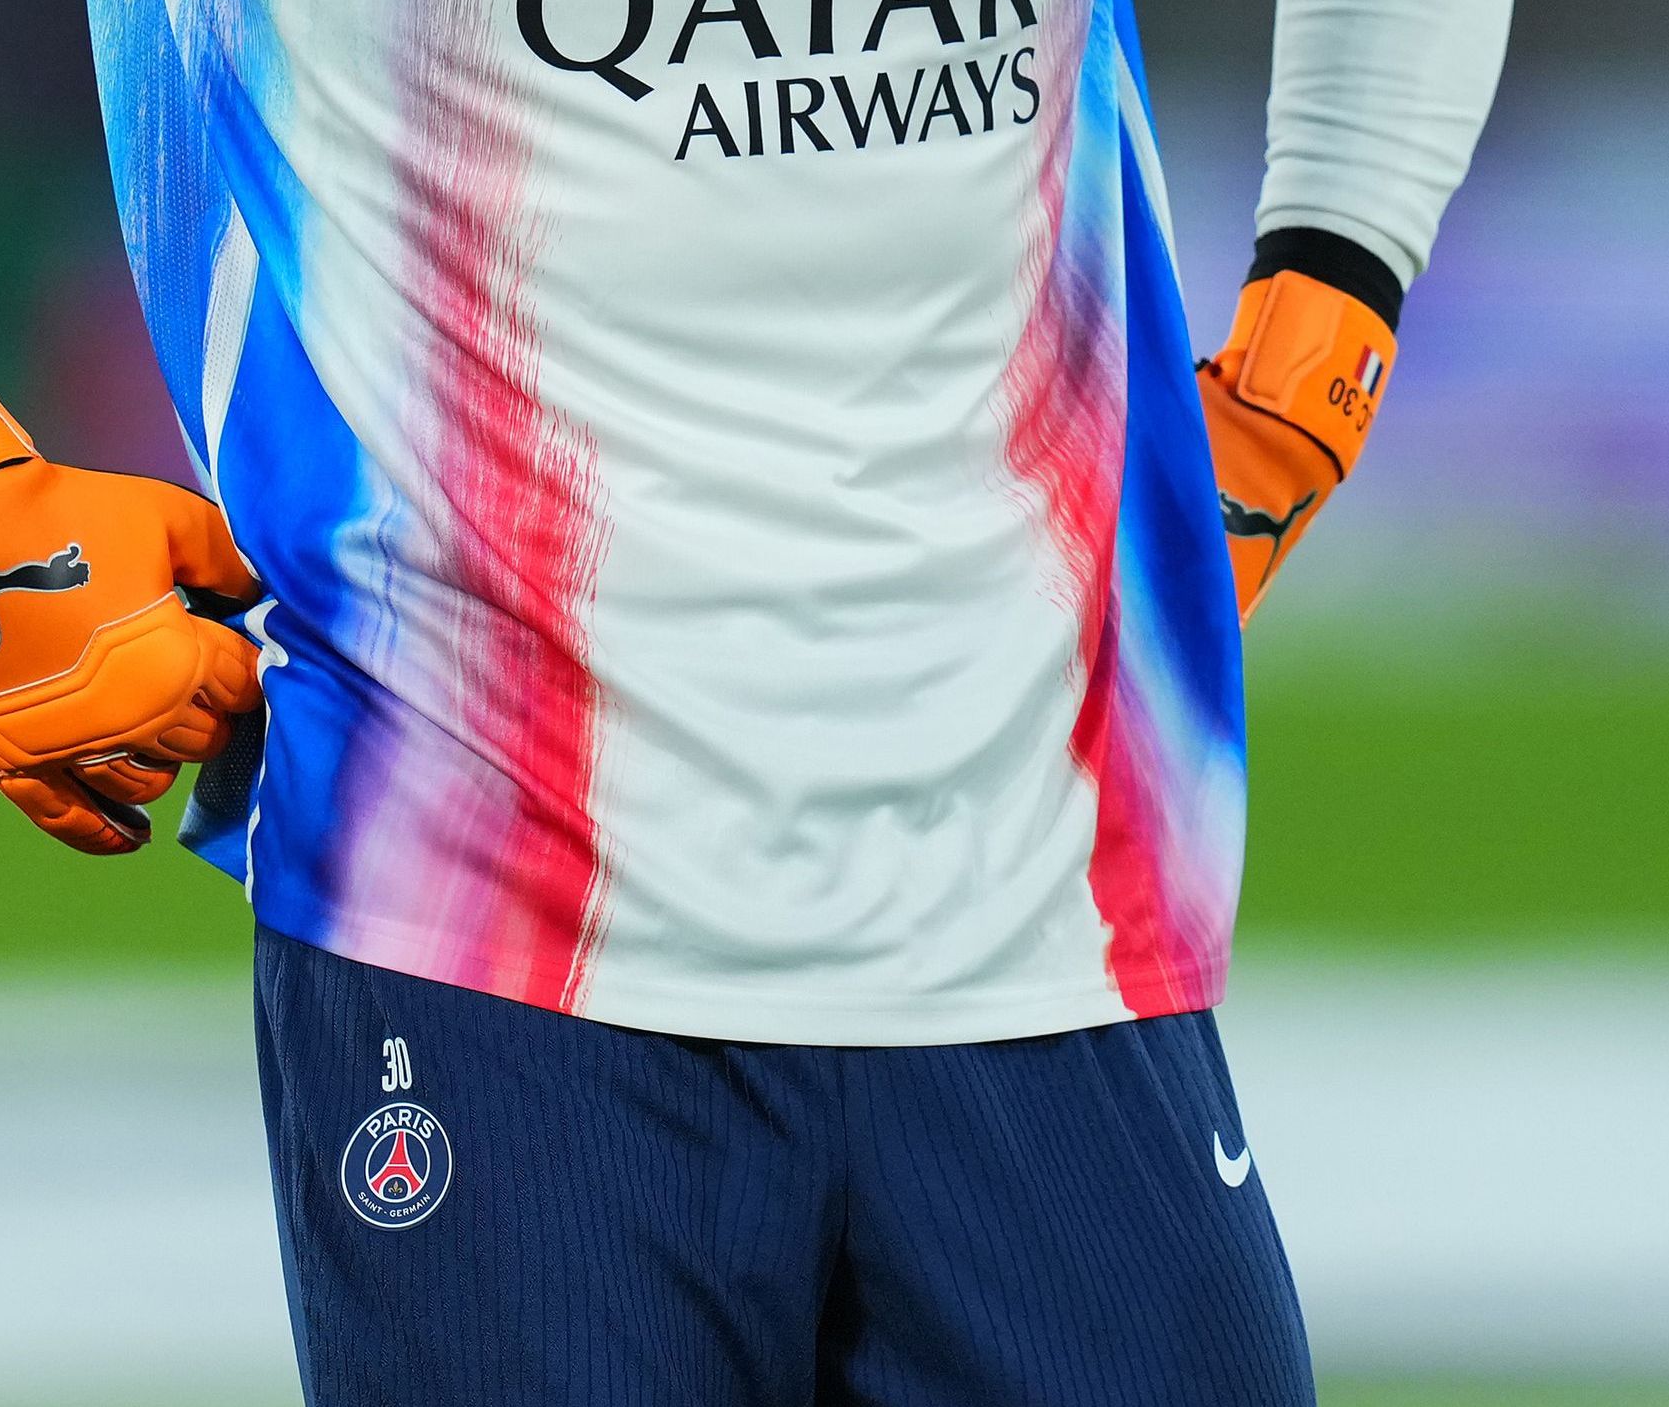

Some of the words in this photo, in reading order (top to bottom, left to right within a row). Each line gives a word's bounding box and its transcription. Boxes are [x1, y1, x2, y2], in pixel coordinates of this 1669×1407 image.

[674, 47, 1041, 161] AIRWAYS
[1328, 377, 1359, 417] 30
[381, 1036, 413, 1092] 30
[365, 1108, 435, 1140] PARIS
